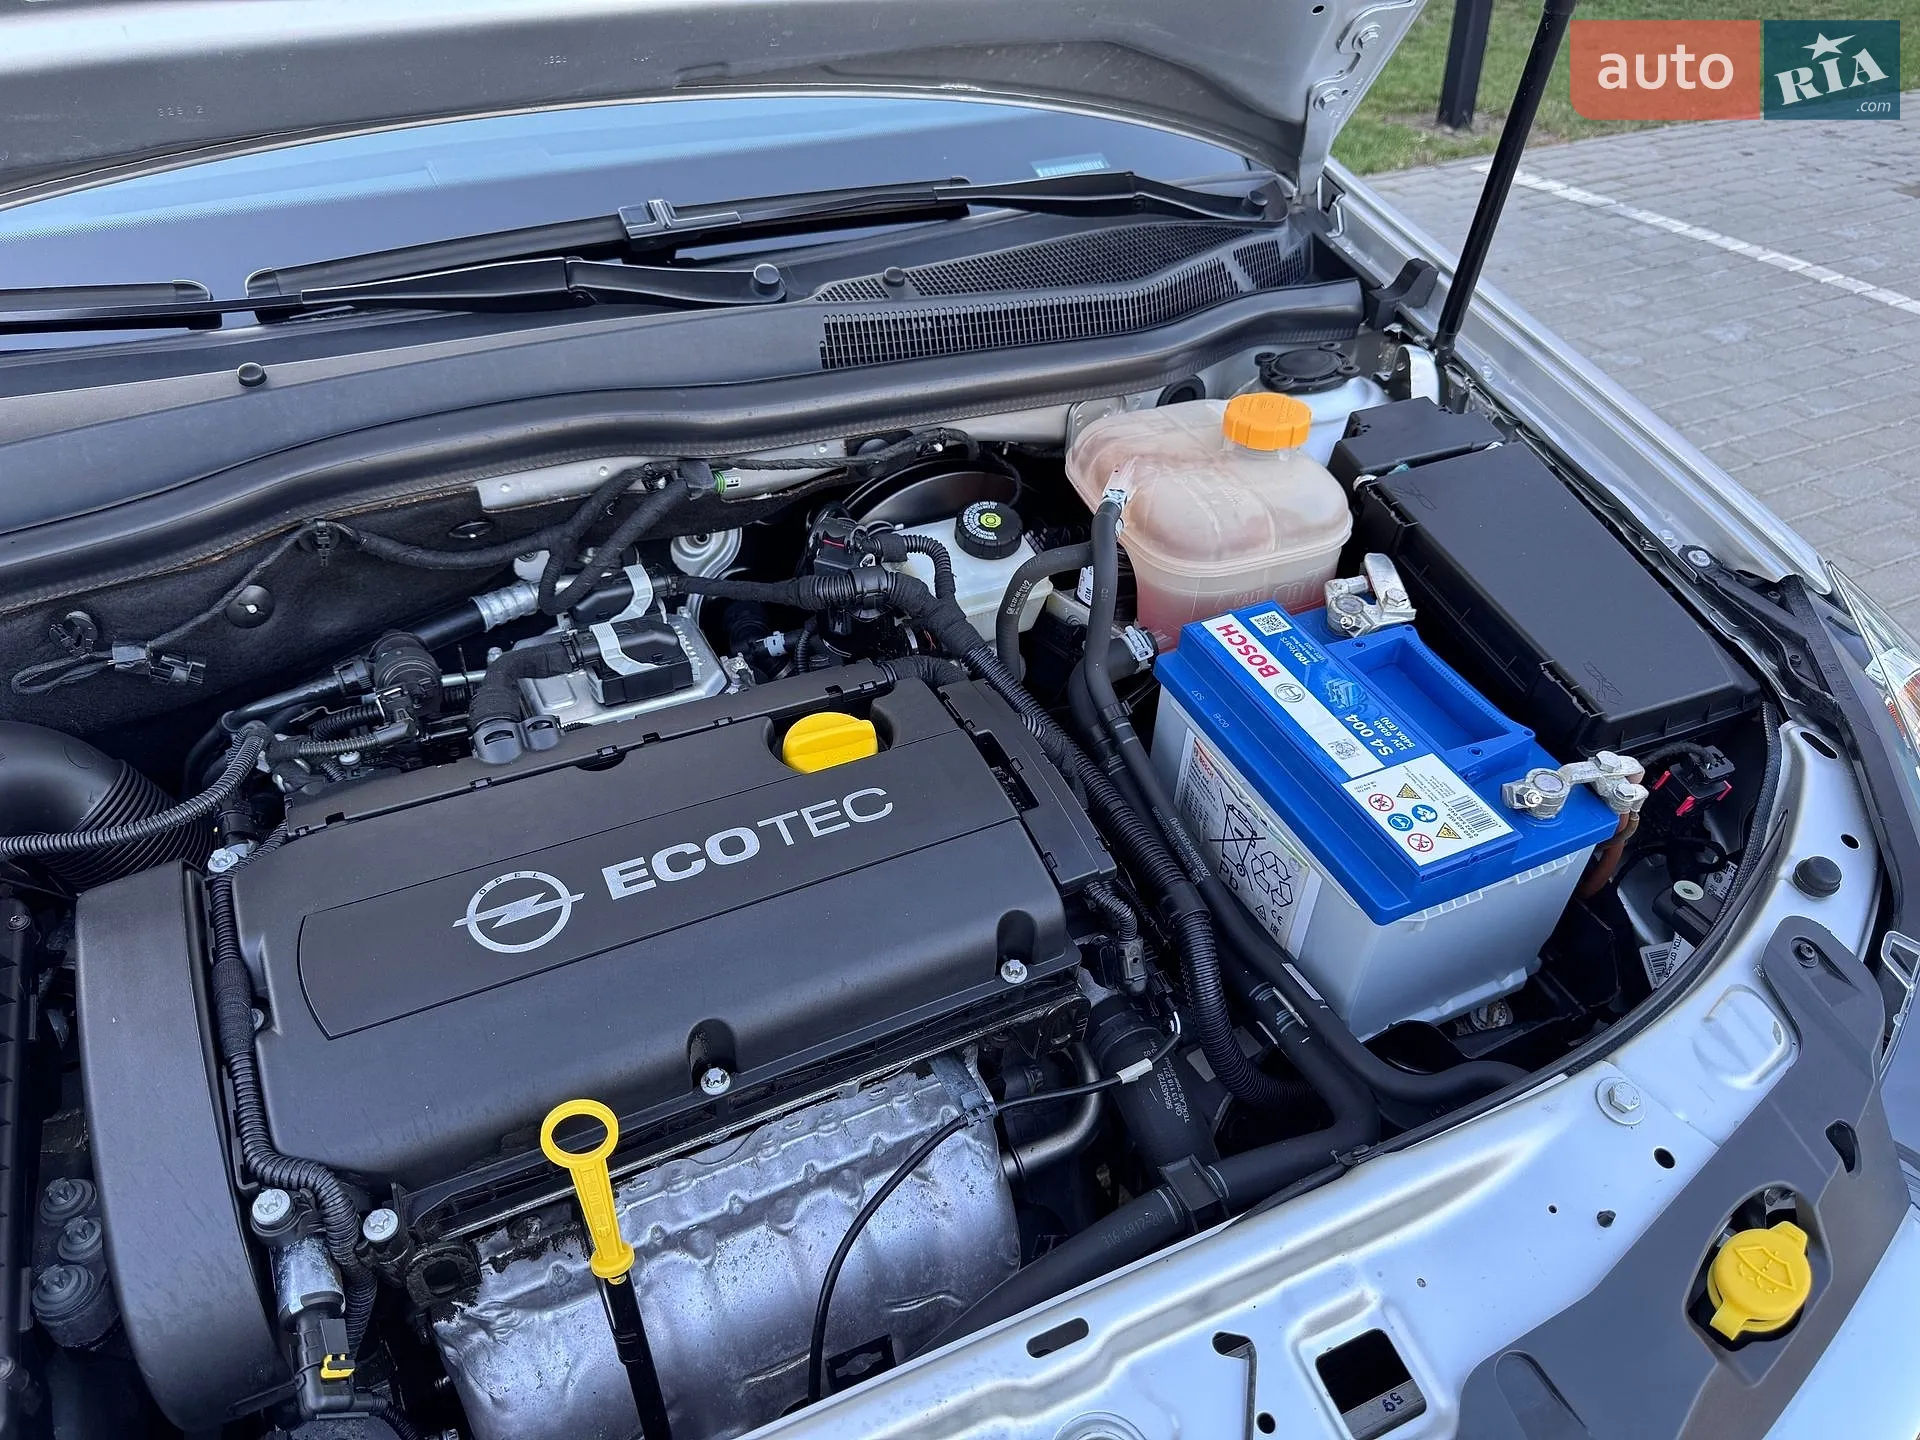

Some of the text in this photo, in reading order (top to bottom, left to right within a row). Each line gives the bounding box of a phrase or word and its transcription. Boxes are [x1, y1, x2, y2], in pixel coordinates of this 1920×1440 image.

[1216, 623, 1281, 678] BOSCH
[1344, 714, 1394, 756] S4 004
[1372, 720, 1408, 751] 12V 60Ah
[1380, 716, 1416, 749] 540A (EN)
[1199, 756, 1215, 778] BOSCH
[601, 787, 893, 900] ECOTEC
[478, 872, 539, 896] OPEL
[1219, 861, 1239, 890] Pb
